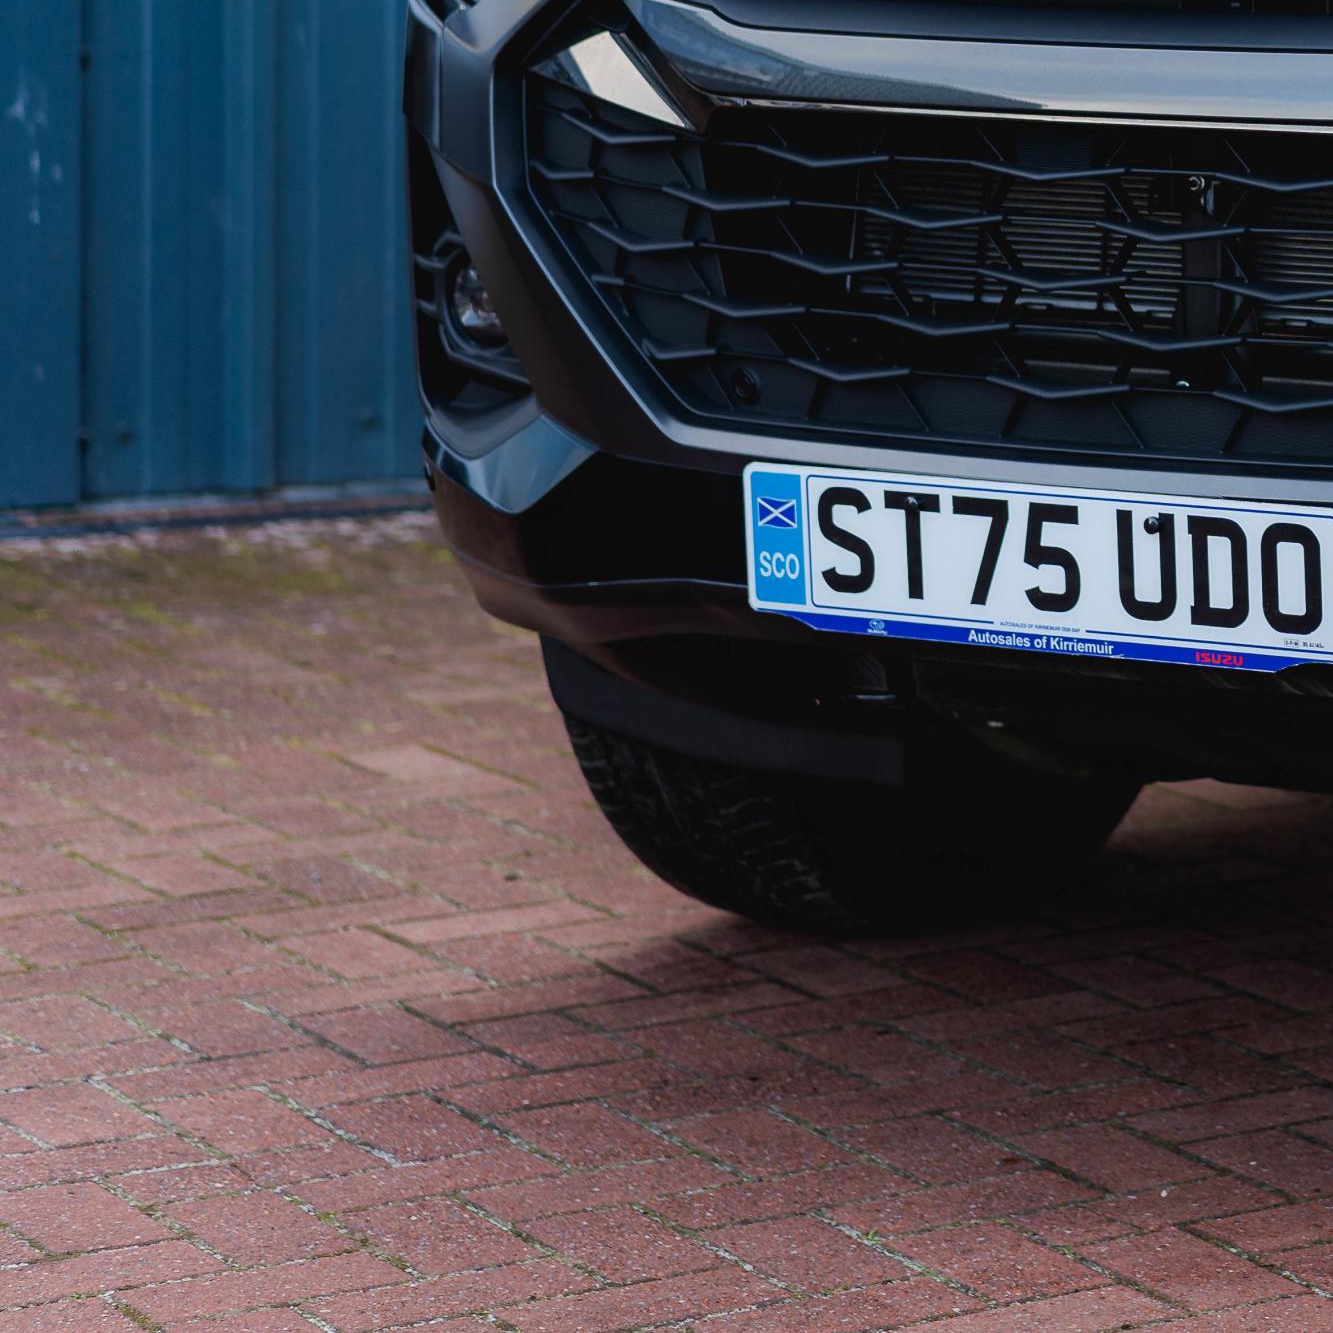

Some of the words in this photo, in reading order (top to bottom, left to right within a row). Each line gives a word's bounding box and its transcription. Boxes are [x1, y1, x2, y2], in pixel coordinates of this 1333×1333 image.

[760, 550, 800, 580] SCO
[816, 486, 1081, 613] ST75
[1115, 509, 1324, 635] UDO
[968, 629, 1031, 648] Autosales
[1034, 635, 1048, 649] of
[1050, 636, 1114, 655] Kirriemuir
[1195, 651, 1244, 667] ISUZU
